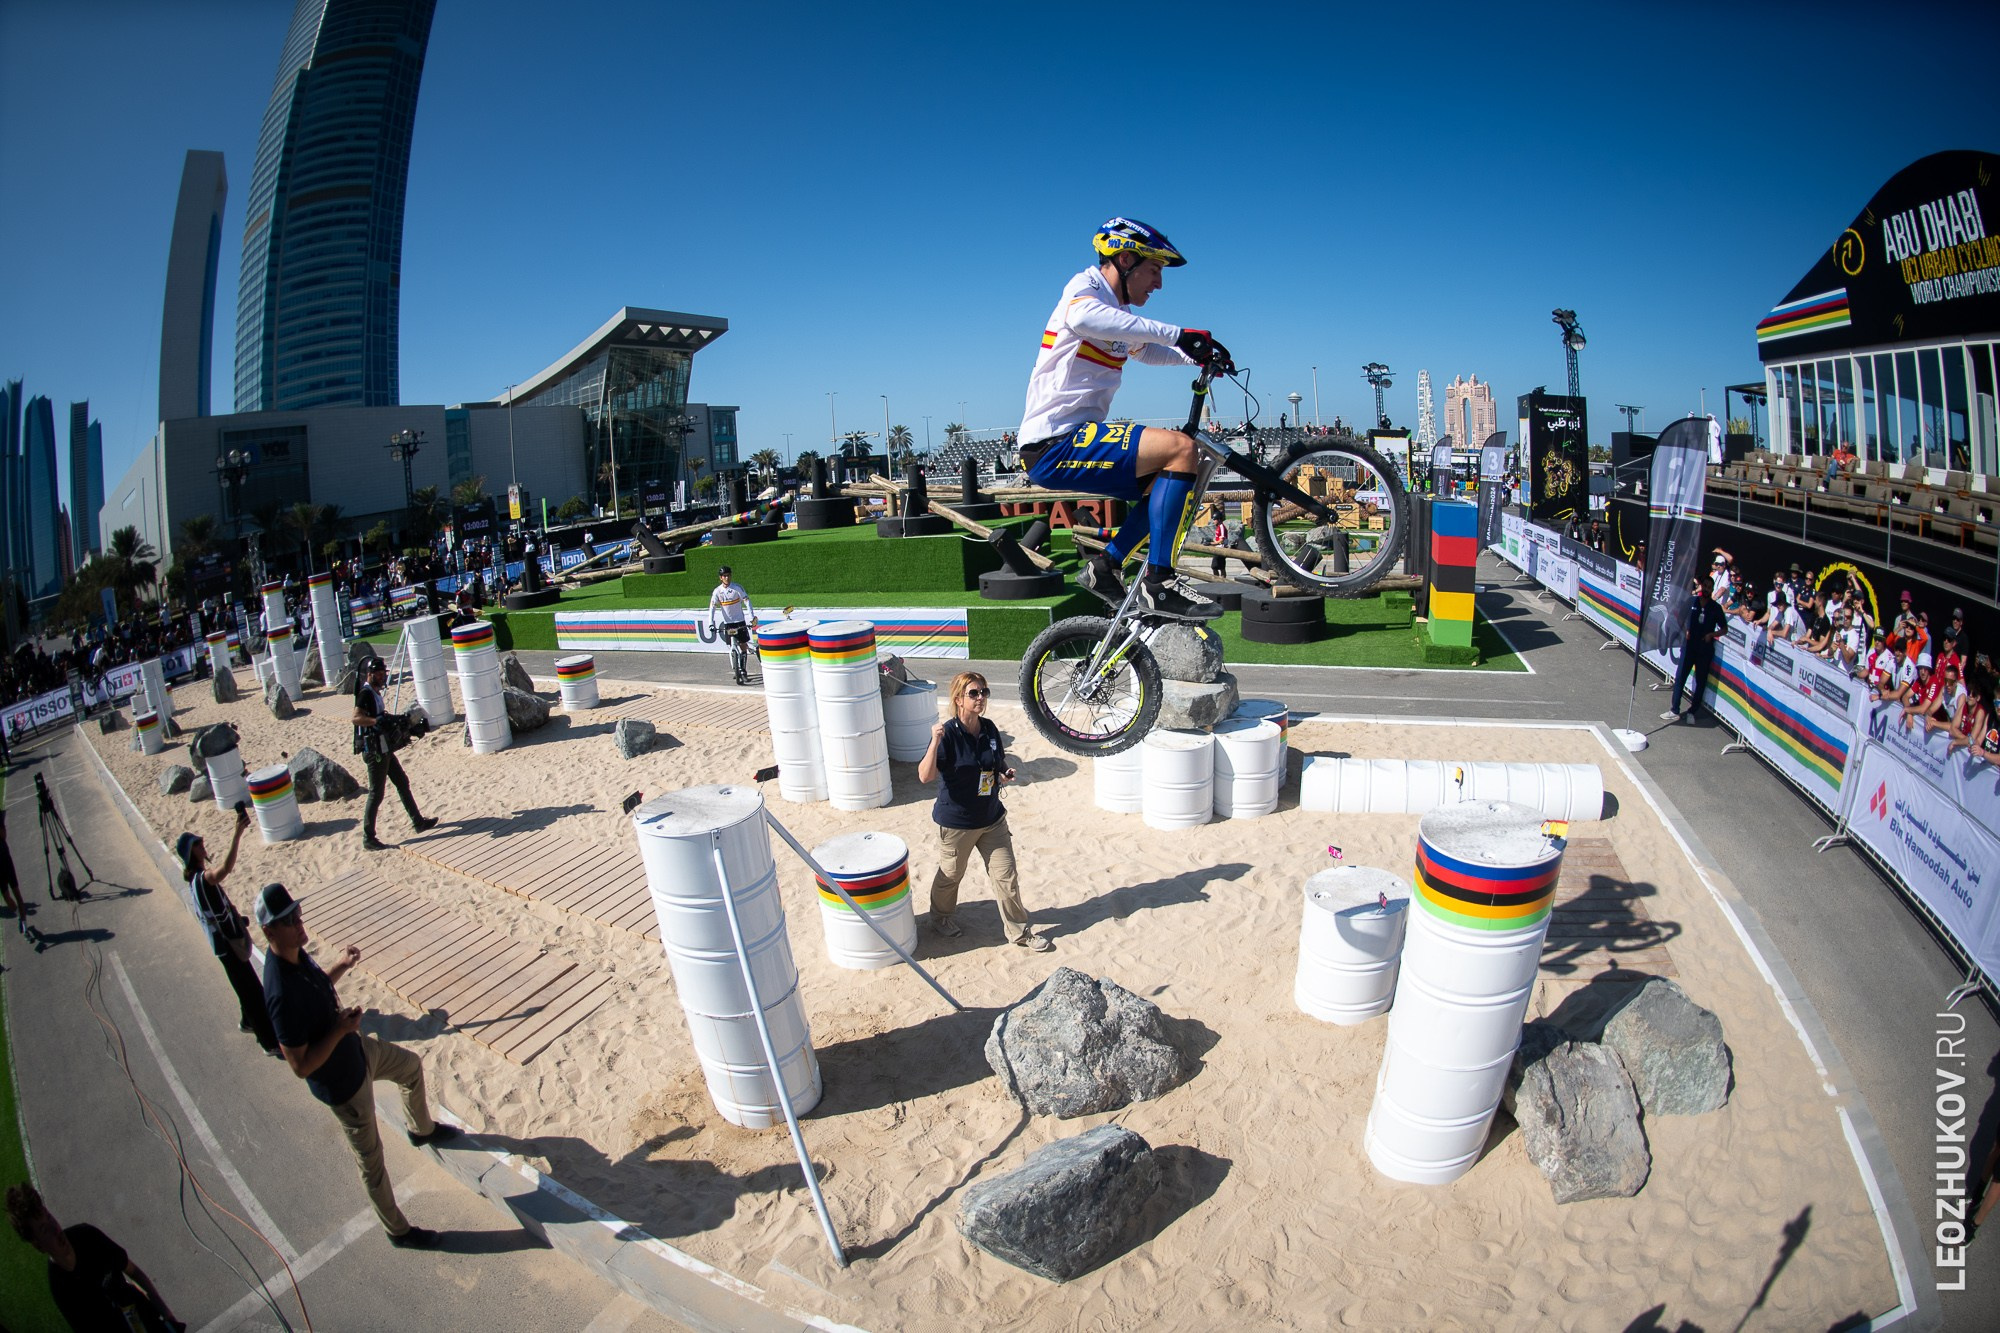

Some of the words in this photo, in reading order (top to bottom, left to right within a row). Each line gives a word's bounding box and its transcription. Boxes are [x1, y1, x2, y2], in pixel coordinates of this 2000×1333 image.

[1882, 209, 1922, 264] ABU
[1919, 188, 1986, 252] DHABI
[1901, 257, 1921, 284] UCI
[1919, 247, 1958, 280] URBAN
[1909, 278, 1943, 304] WORLD
[1547, 417, 1566, 432] ظبي
[1488, 451, 1499, 471] 3
[1668, 456, 1686, 496] 2
[463, 519, 490, 531] 13:00:22
[1660, 573, 1672, 602] Sports
[1666, 540, 1676, 572] Council
[1801, 669, 1815, 685] UCI
[1889, 817, 1904, 840] Bin
[1904, 831, 1951, 885] Hamoodah
[1950, 878, 1973, 909] Auto
